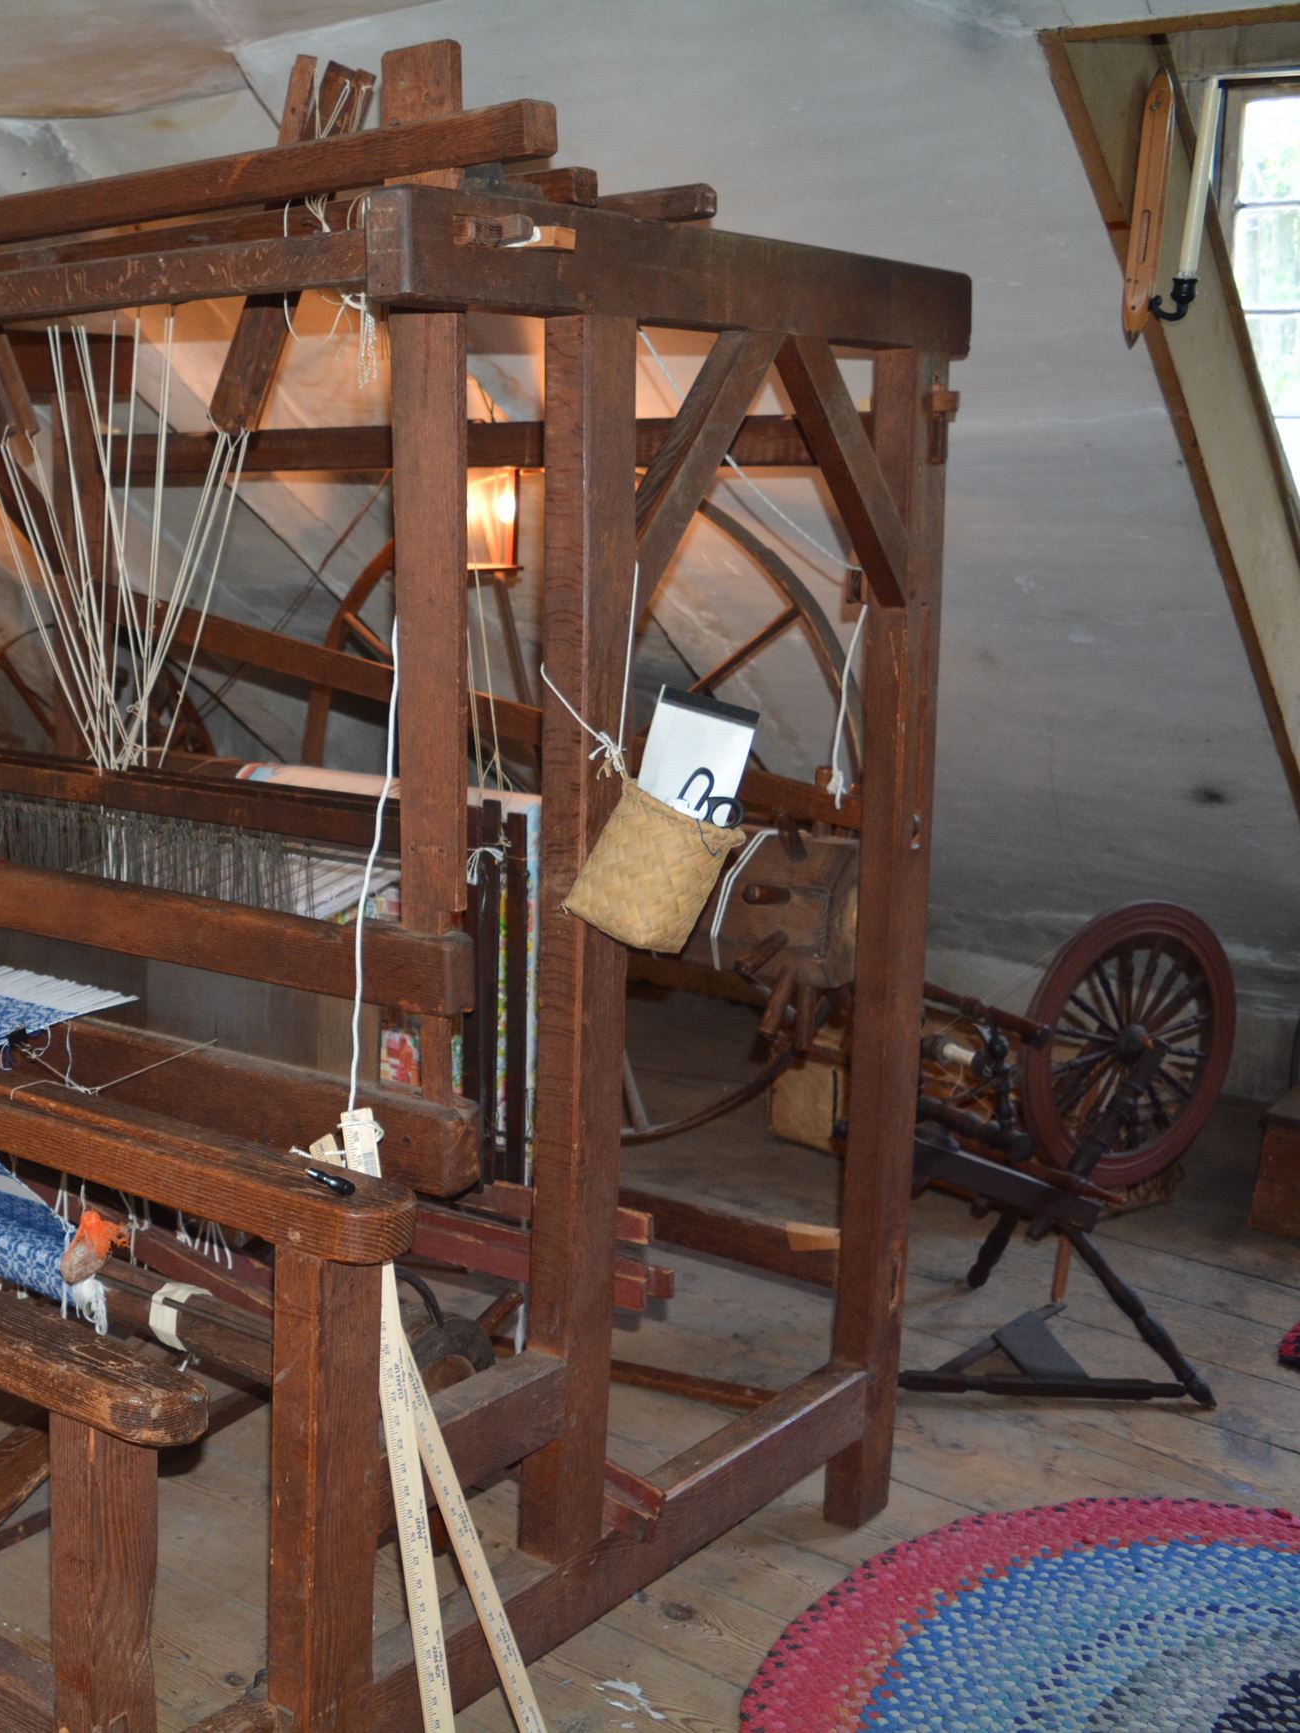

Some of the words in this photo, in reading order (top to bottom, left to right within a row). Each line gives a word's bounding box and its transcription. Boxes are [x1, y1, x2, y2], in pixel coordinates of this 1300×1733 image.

[394, 1362, 400, 1372] UP
[407, 1371, 414, 1382] UP
[395, 1374, 403, 1399] CLEAN
[411, 1383, 423, 1406] CLEAN
[400, 1462, 406, 1473] 21
[404, 1485, 409, 1496] 20
[407, 1508, 413, 1519] 19
[415, 1517, 423, 1539] PAINT
[410, 1531, 416, 1542] 18
[413, 1555, 419, 1565] 17
[416, 1578, 422, 1589] 16
[420, 1602, 425, 1612] 15
[422, 1625, 428, 1636] 14
